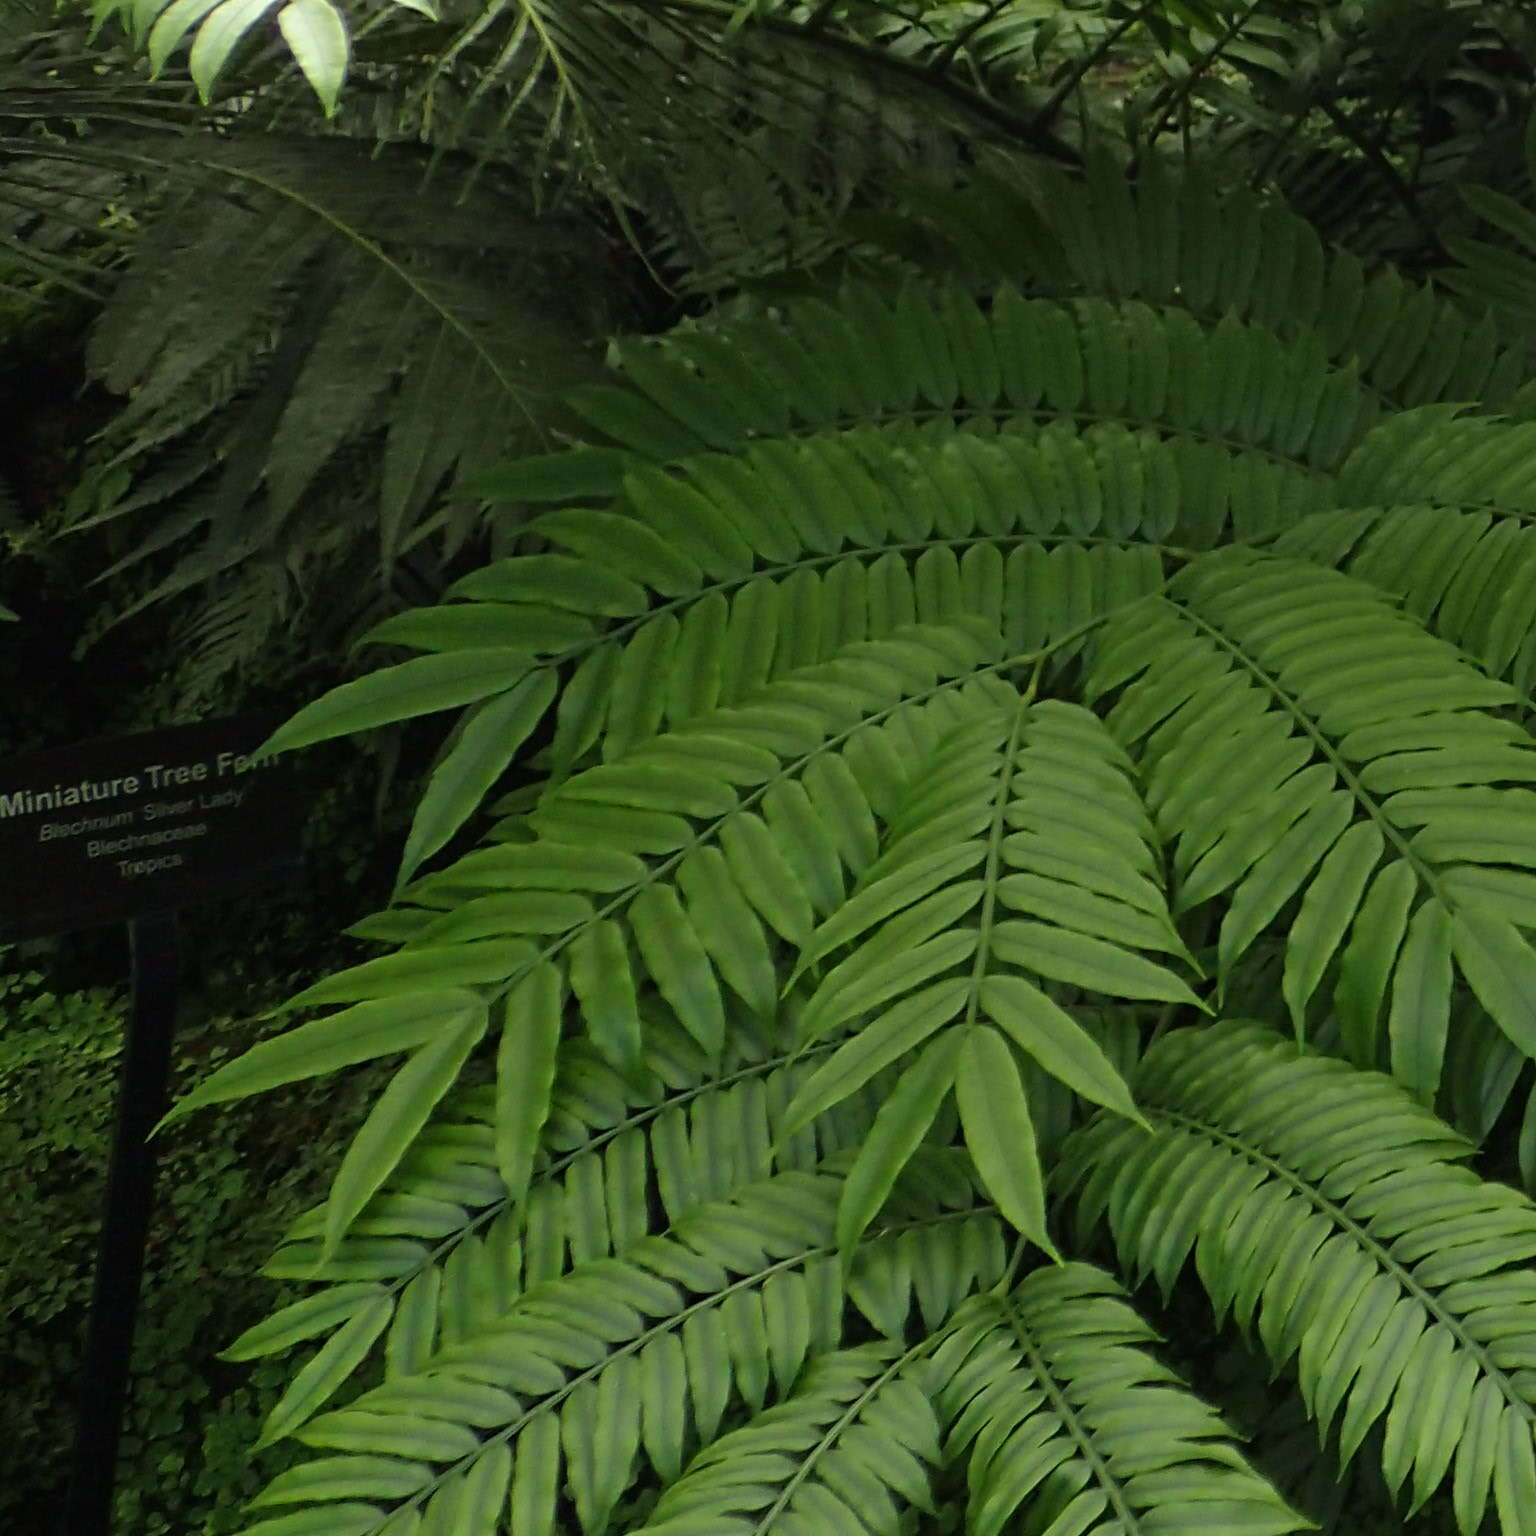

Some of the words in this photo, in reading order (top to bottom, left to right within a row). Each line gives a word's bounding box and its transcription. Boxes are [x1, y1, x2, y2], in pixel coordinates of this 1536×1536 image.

[0, 775, 139, 819] Miniature
[144, 763, 208, 790] Tree
[117, 853, 183, 878] Tropics
